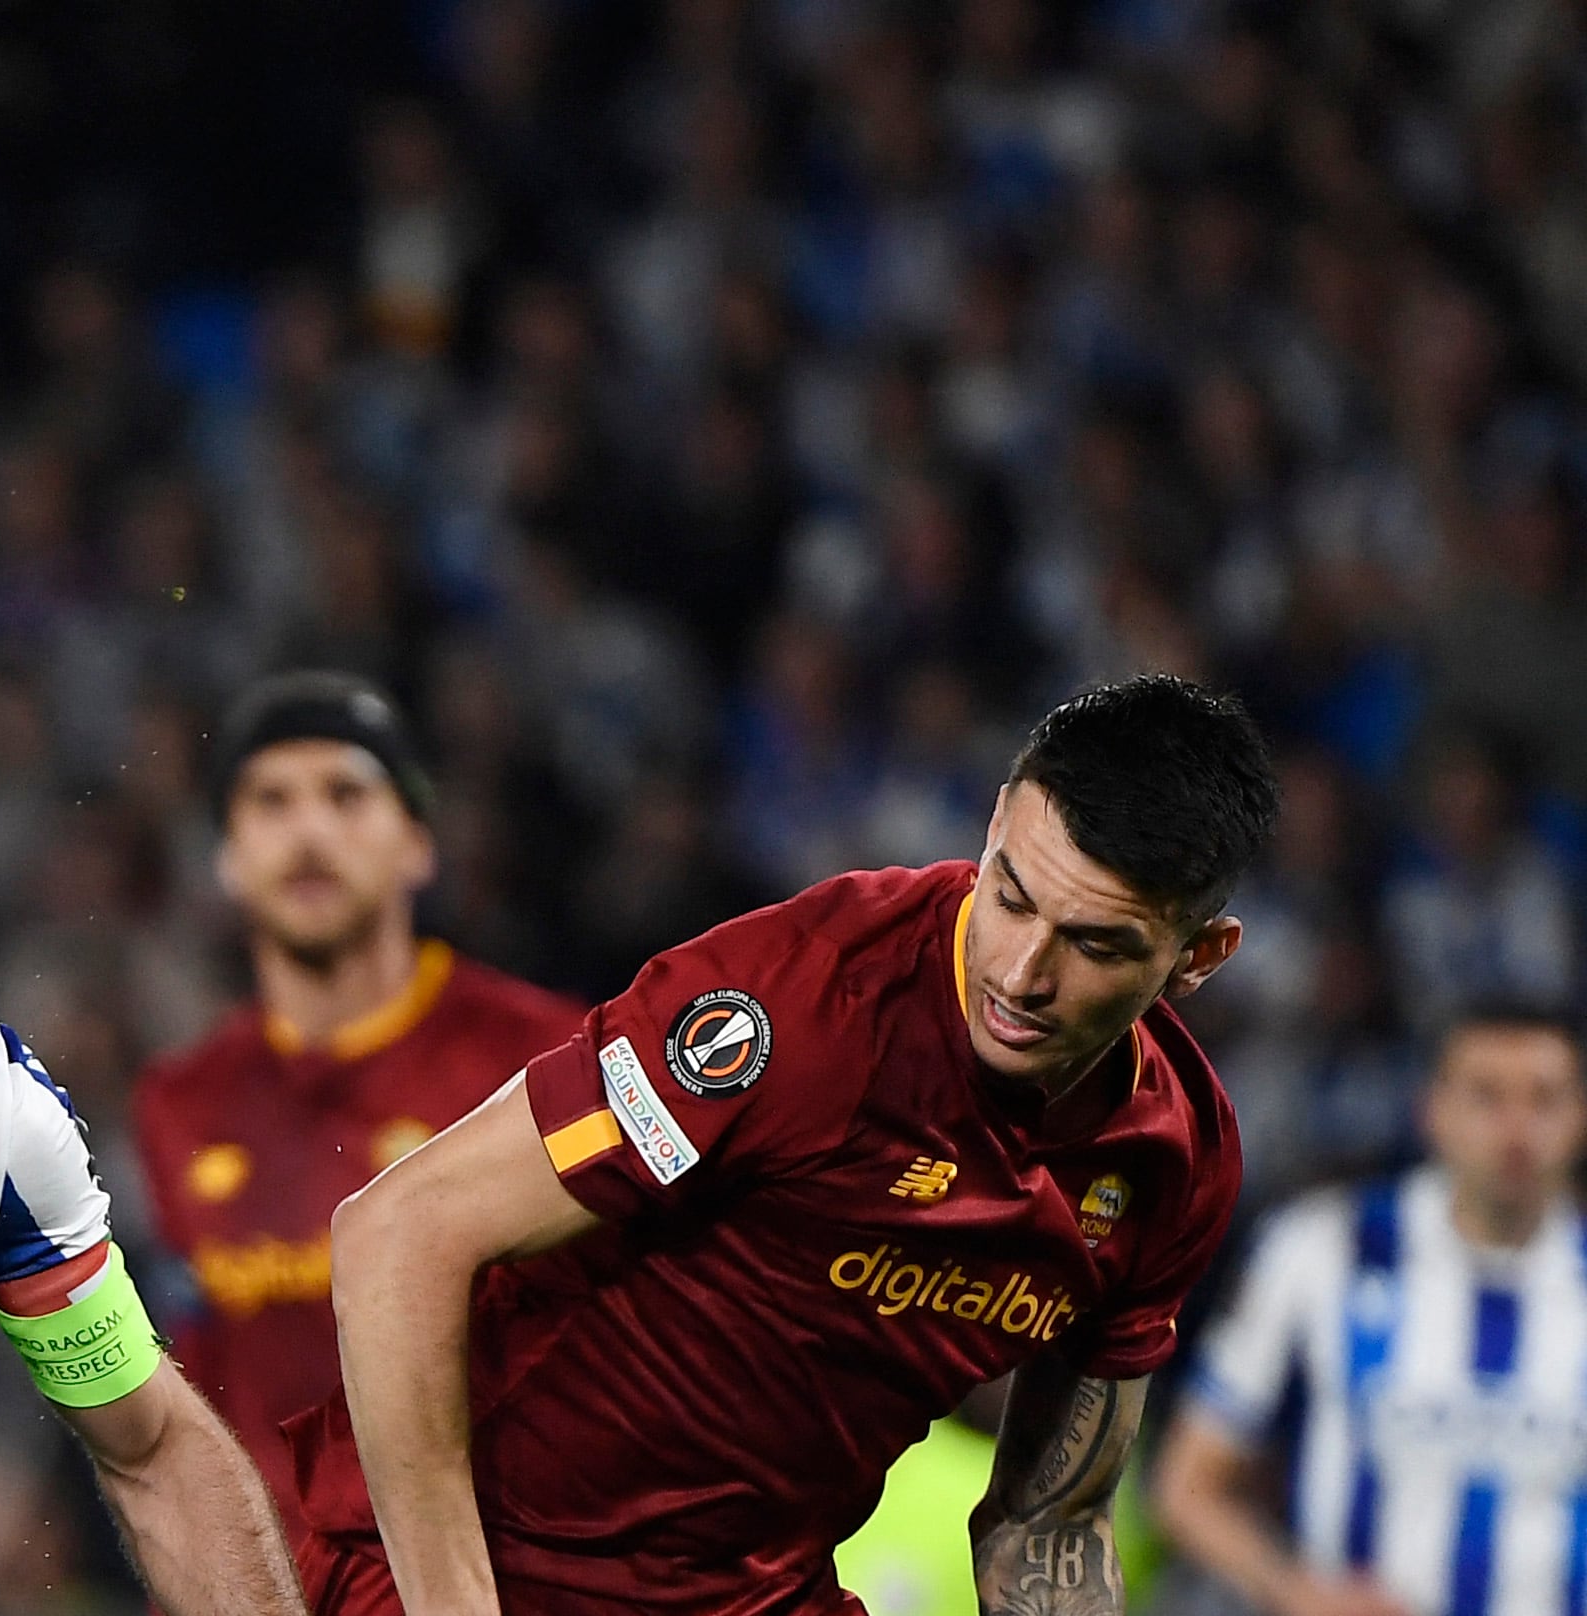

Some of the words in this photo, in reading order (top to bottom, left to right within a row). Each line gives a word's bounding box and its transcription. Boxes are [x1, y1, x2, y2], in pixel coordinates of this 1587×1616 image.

[693, 992, 716, 1006] UEFA
[717, 990, 750, 1002] EUROPA
[748, 1000, 772, 1055] CONFERENCE
[616, 1042, 635, 1071] UEFA
[740, 1055, 768, 1089] LEAGUE
[669, 1061, 704, 1096] WINNERS
[829, 1244, 1078, 1341] digitalbit
[47, 1309, 123, 1352] RACISM
[44, 1341, 125, 1380] RESPECT
